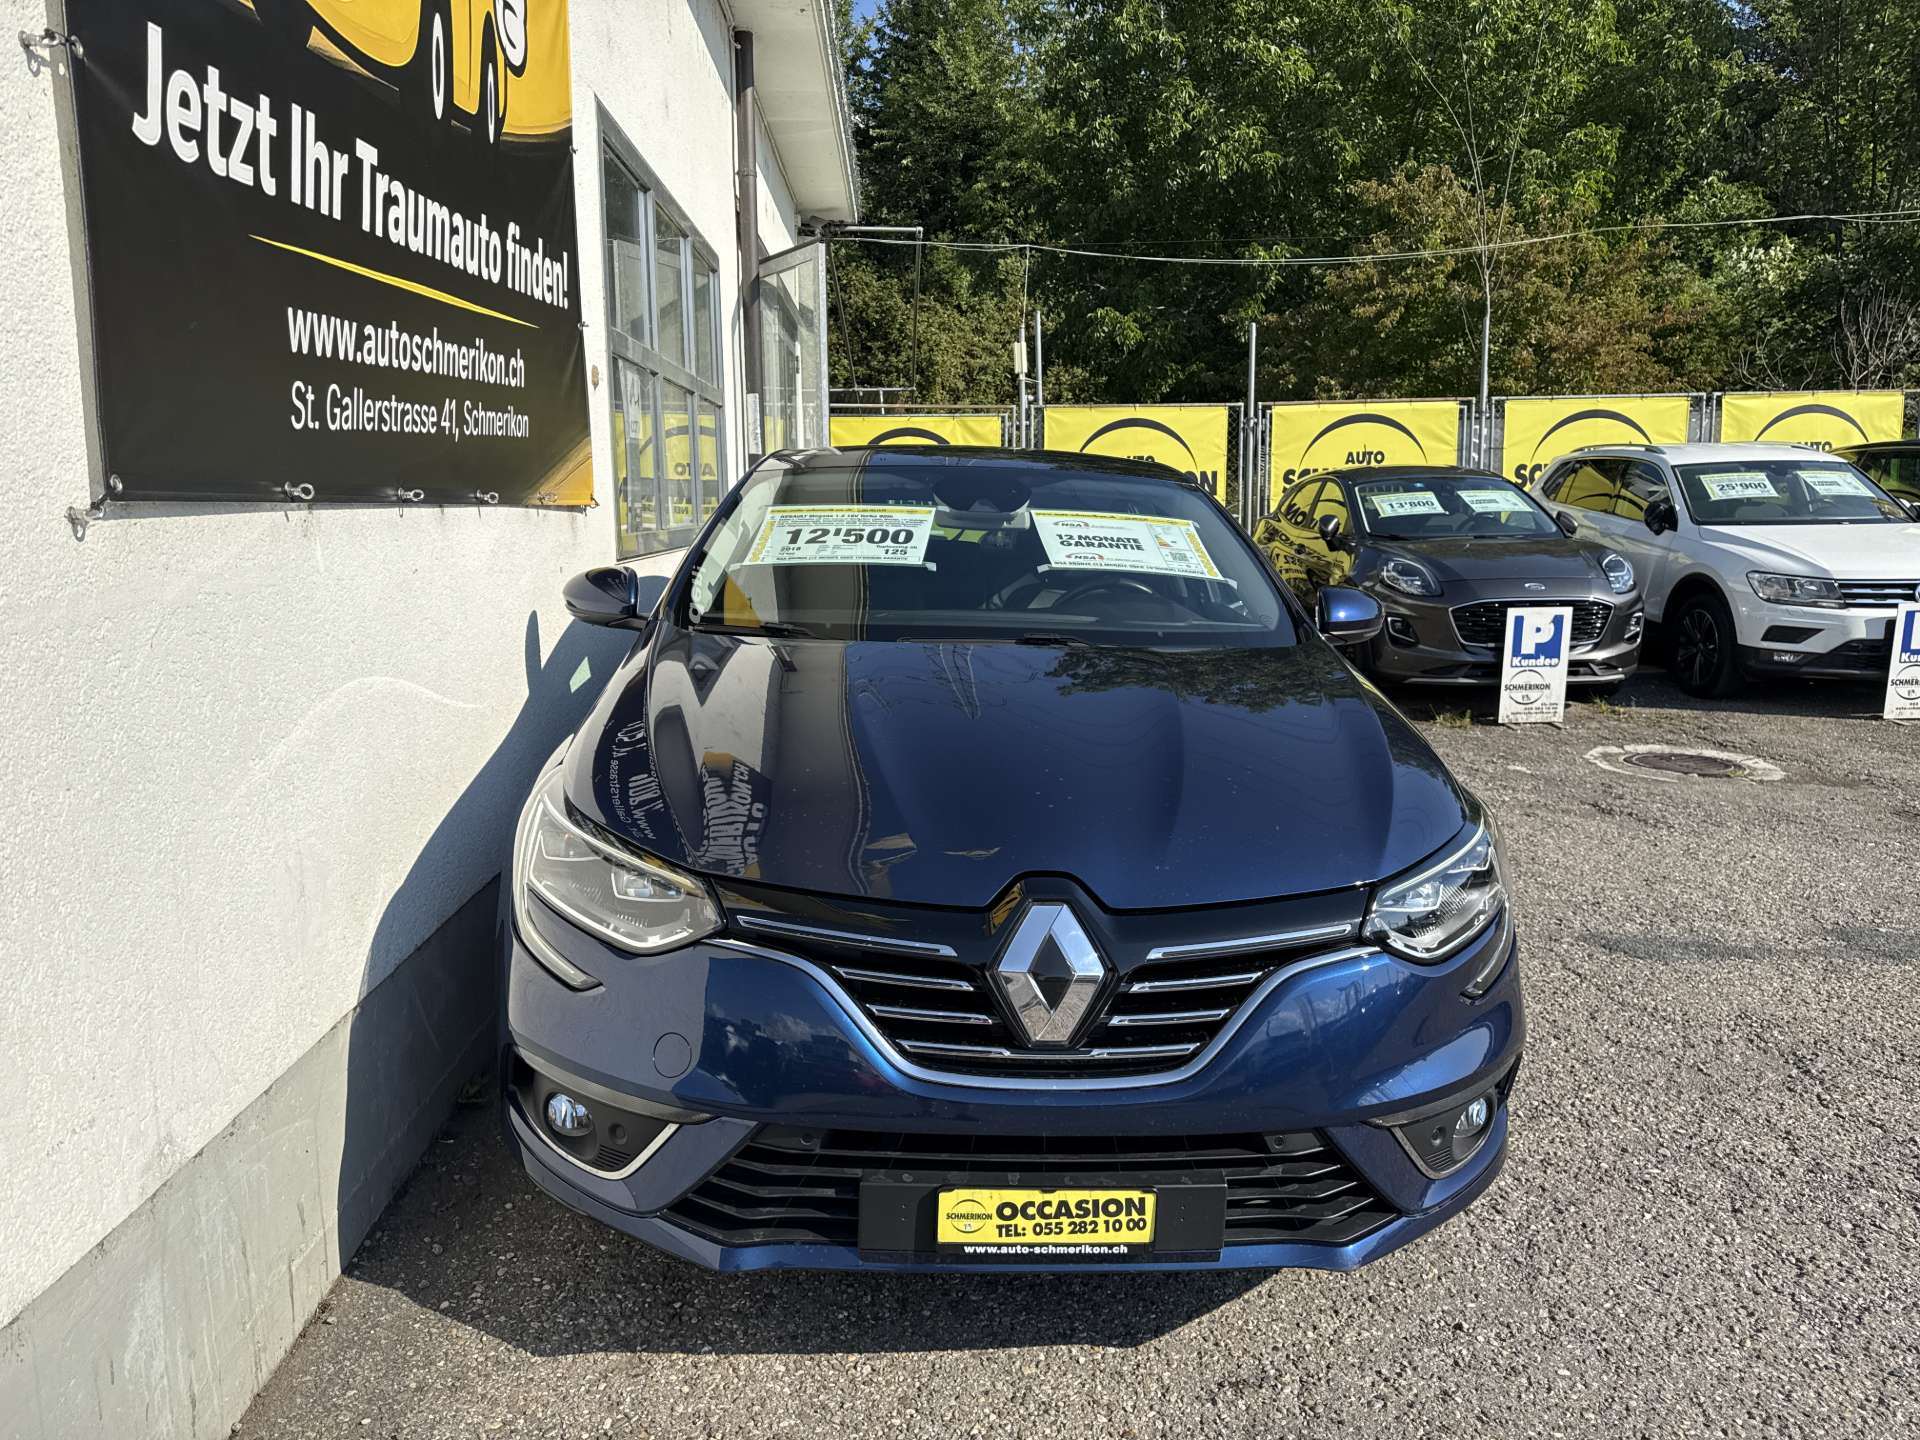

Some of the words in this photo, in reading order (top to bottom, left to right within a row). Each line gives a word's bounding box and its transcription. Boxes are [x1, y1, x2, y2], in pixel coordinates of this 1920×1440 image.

[132, 21, 277, 196] Jetzt
[290, 102, 348, 221] Ihr
[355, 139, 501, 285] Traumauto
[506, 222, 569, 309] finden!
[287, 306, 525, 388] www.autoschmerikon.ch
[290, 381, 319, 430] St.
[326, 384, 437, 434] Gallerstrasse
[440, 403, 460, 443] 41,
[463, 403, 529, 438] Schmerikon
[1345, 450, 1385, 465] AUTO
[1716, 482, 1768, 491] 25'900
[1387, 500, 1435, 509] 13'800
[786, 527, 914, 545] 12'500
[1056, 533, 1074, 541] 12
[1078, 534, 1140, 545] MONATE
[1059, 540, 1145, 551] GARANTIE
[883, 548, 908, 556] 125
[1521, 615, 1555, 655] P
[1512, 656, 1559, 667] Kunden
[1504, 683, 1551, 691] SCHMERIKON
[1890, 678, 1920, 687] SCHMER
[995, 1197, 1146, 1221] OCCASION
[946, 1212, 993, 1220] SCHMERIKON
[996, 1224, 1026, 1238] TEL:
[1032, 1222, 1063, 1236] 055
[1067, 1220, 1099, 1235] 282
[1103, 1219, 1123, 1233] 10
[1126, 1218, 1147, 1231] 00
[964, 1244, 1128, 1254] www.auto-schmerikon.ch
